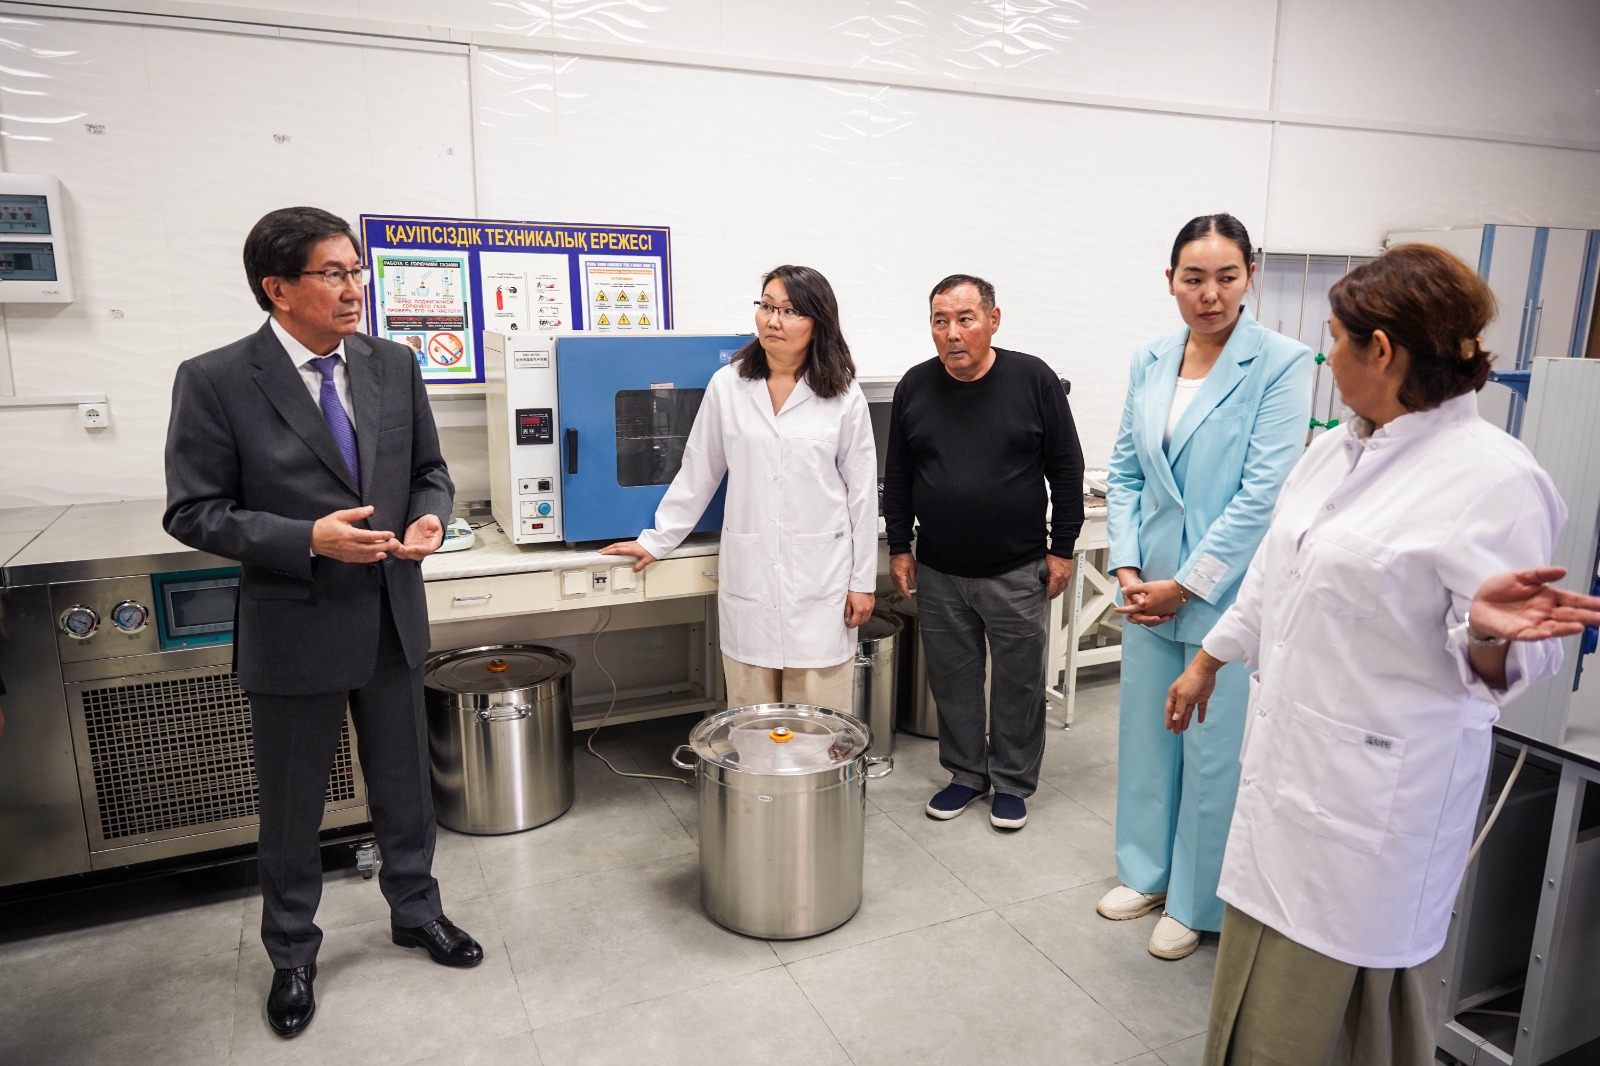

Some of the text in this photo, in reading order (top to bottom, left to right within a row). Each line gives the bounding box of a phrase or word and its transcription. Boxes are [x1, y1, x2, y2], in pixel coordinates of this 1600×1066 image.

[385, 224, 653, 251] ҚАУІПСІЗДІК ТЕХНИКАЛЫҚ ЕРЕЖЕСІ
